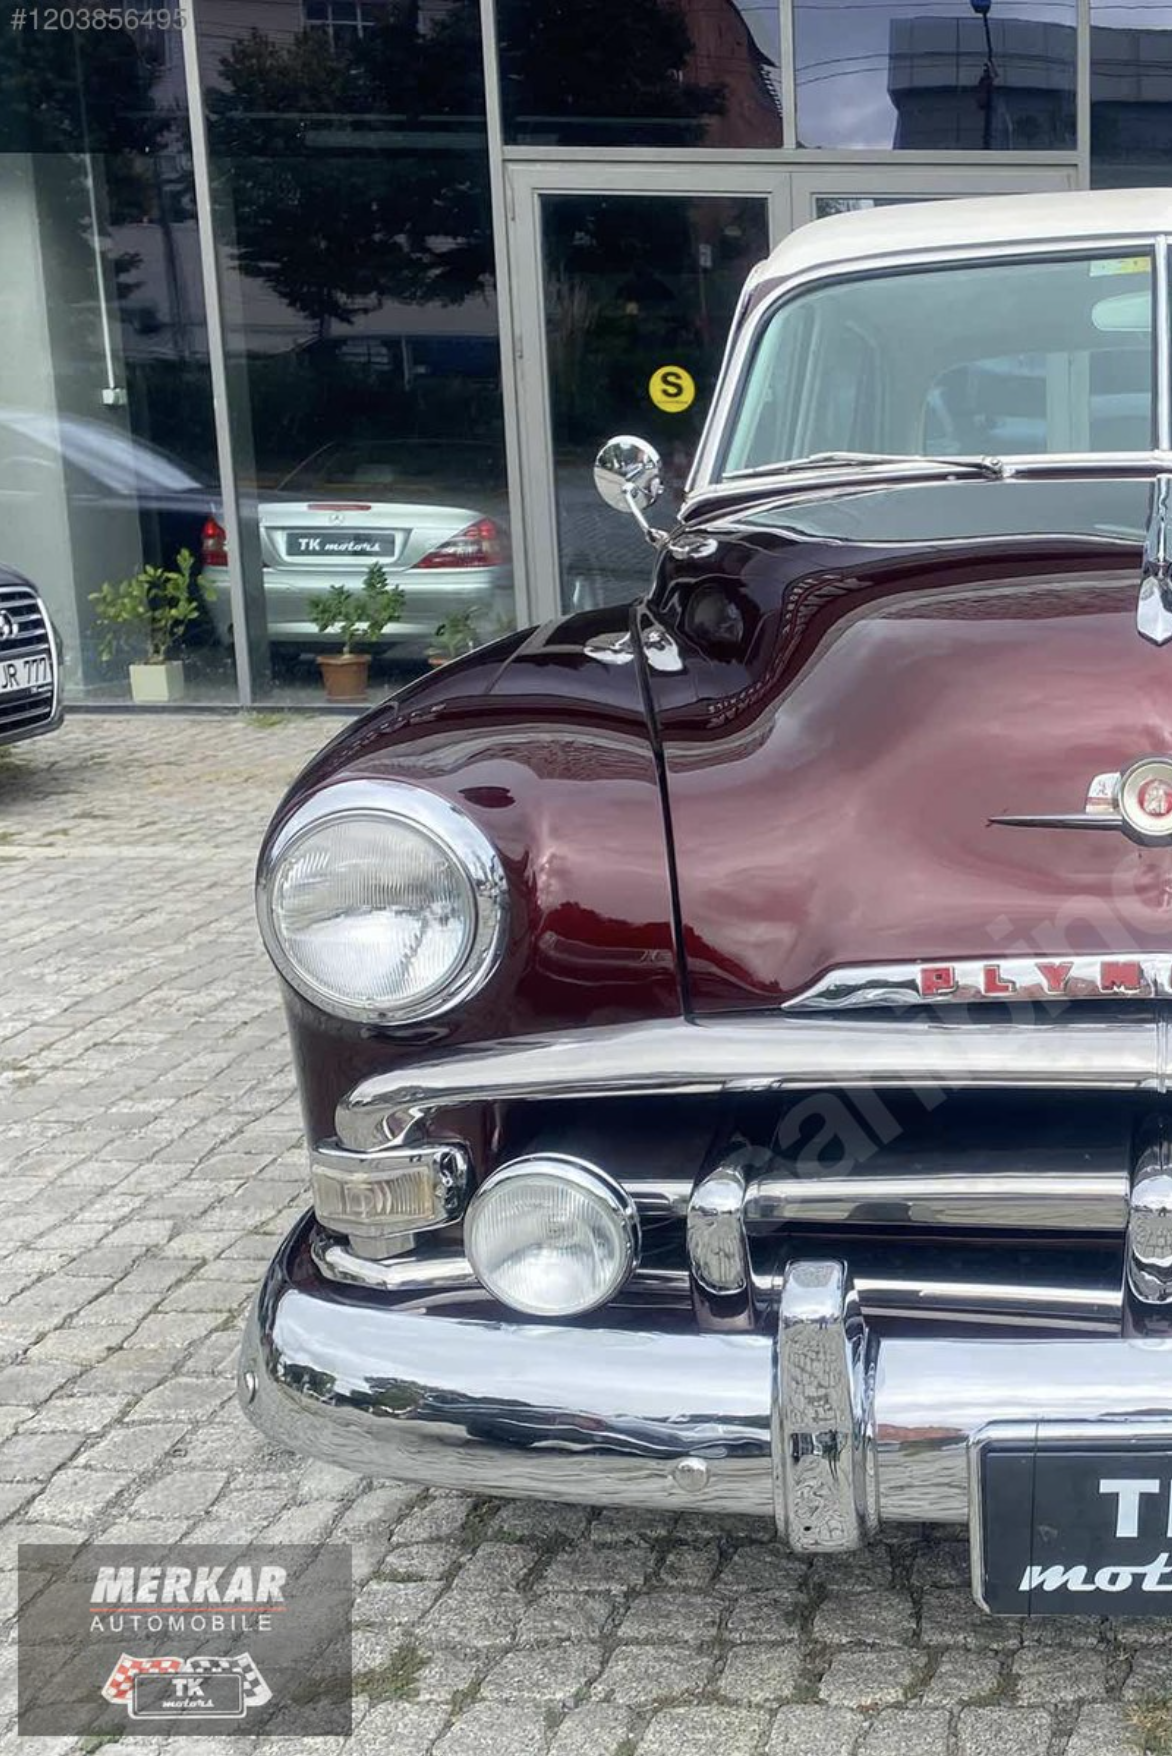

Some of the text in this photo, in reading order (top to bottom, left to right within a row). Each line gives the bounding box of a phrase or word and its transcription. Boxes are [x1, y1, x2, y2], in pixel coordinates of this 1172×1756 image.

[661, 371, 683, 398] S
[298, 538, 380, 552] TK motors
[24, 657, 47, 684] 777
